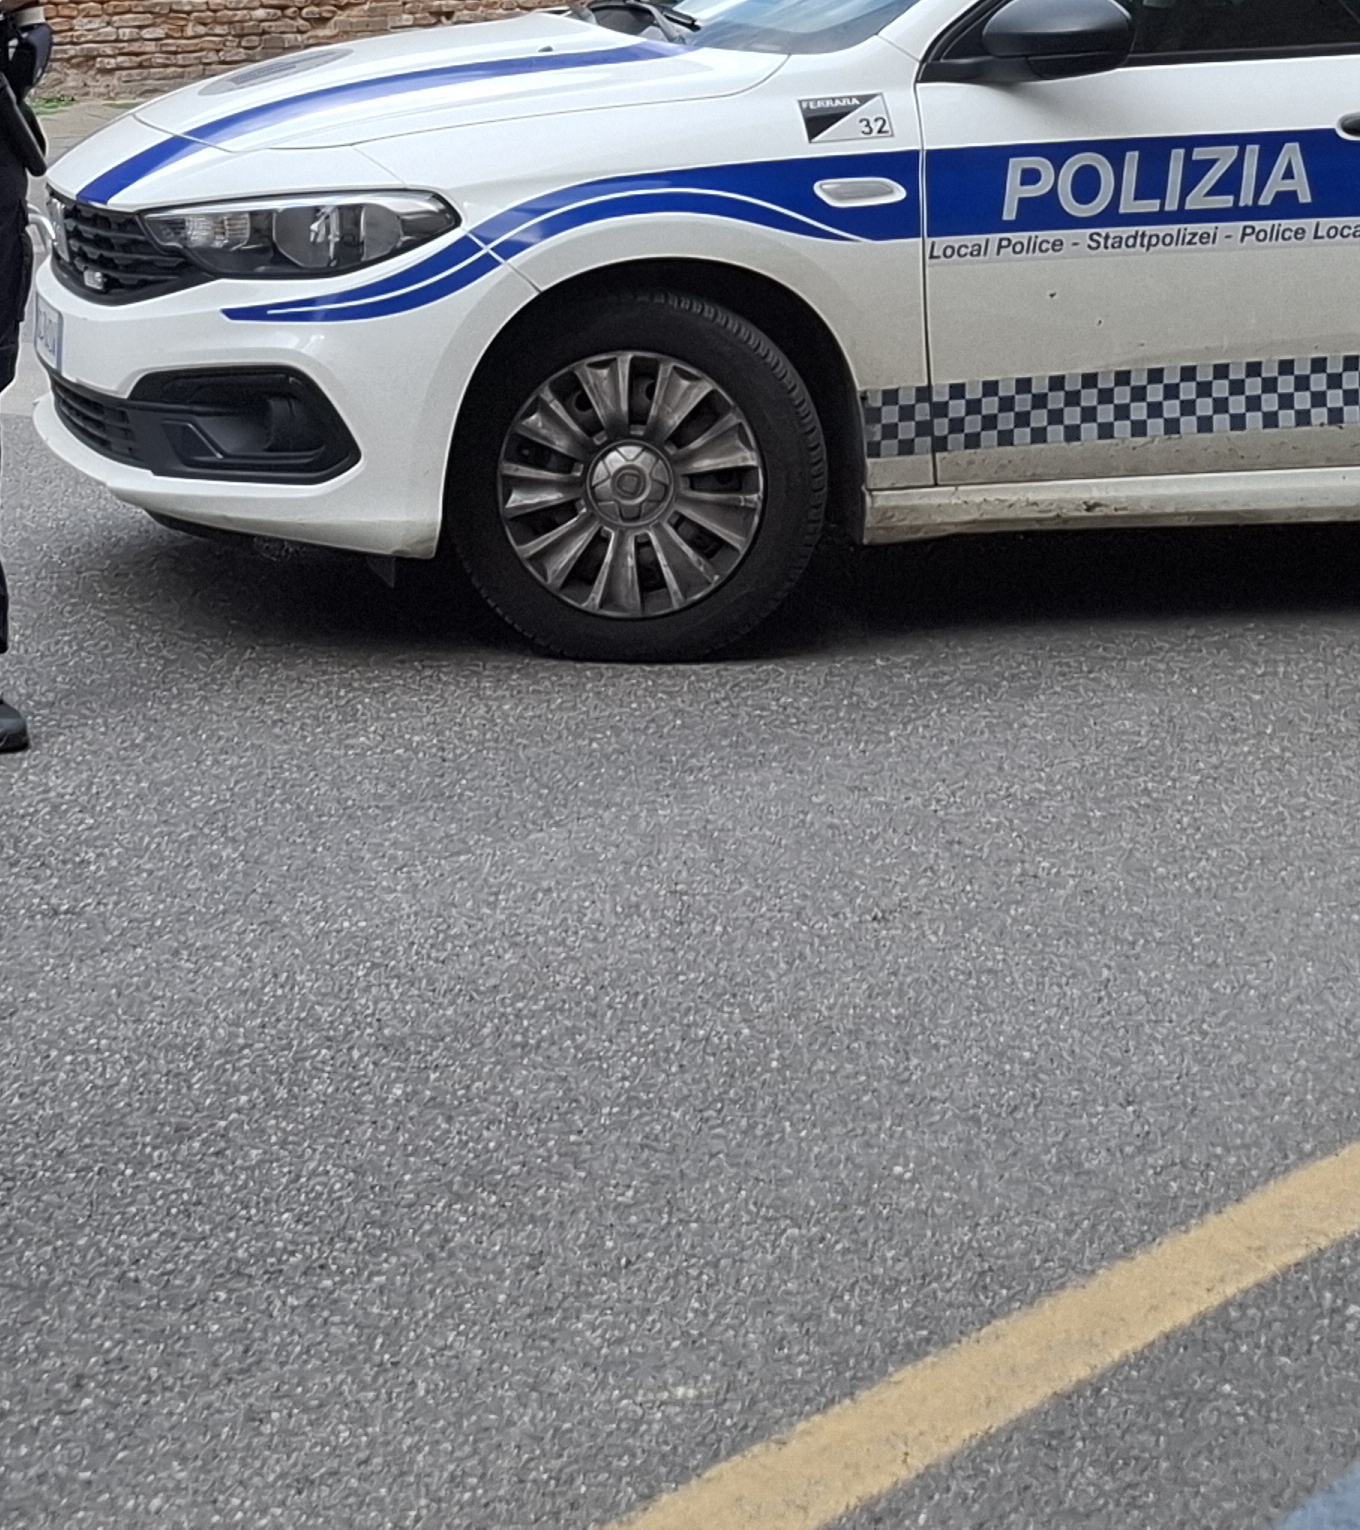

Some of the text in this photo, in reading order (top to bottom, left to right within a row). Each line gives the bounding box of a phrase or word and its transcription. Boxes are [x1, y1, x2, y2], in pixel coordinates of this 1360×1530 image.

[801, 96, 860, 110] FERRARA
[858, 116, 889, 135] 32
[1002, 142, 1313, 221] POLIZIA
[928, 240, 990, 261] Local
[996, 235, 1065, 258] Police
[1086, 226, 1220, 252] Stadtpolizei
[1239, 222, 1307, 245] Police
